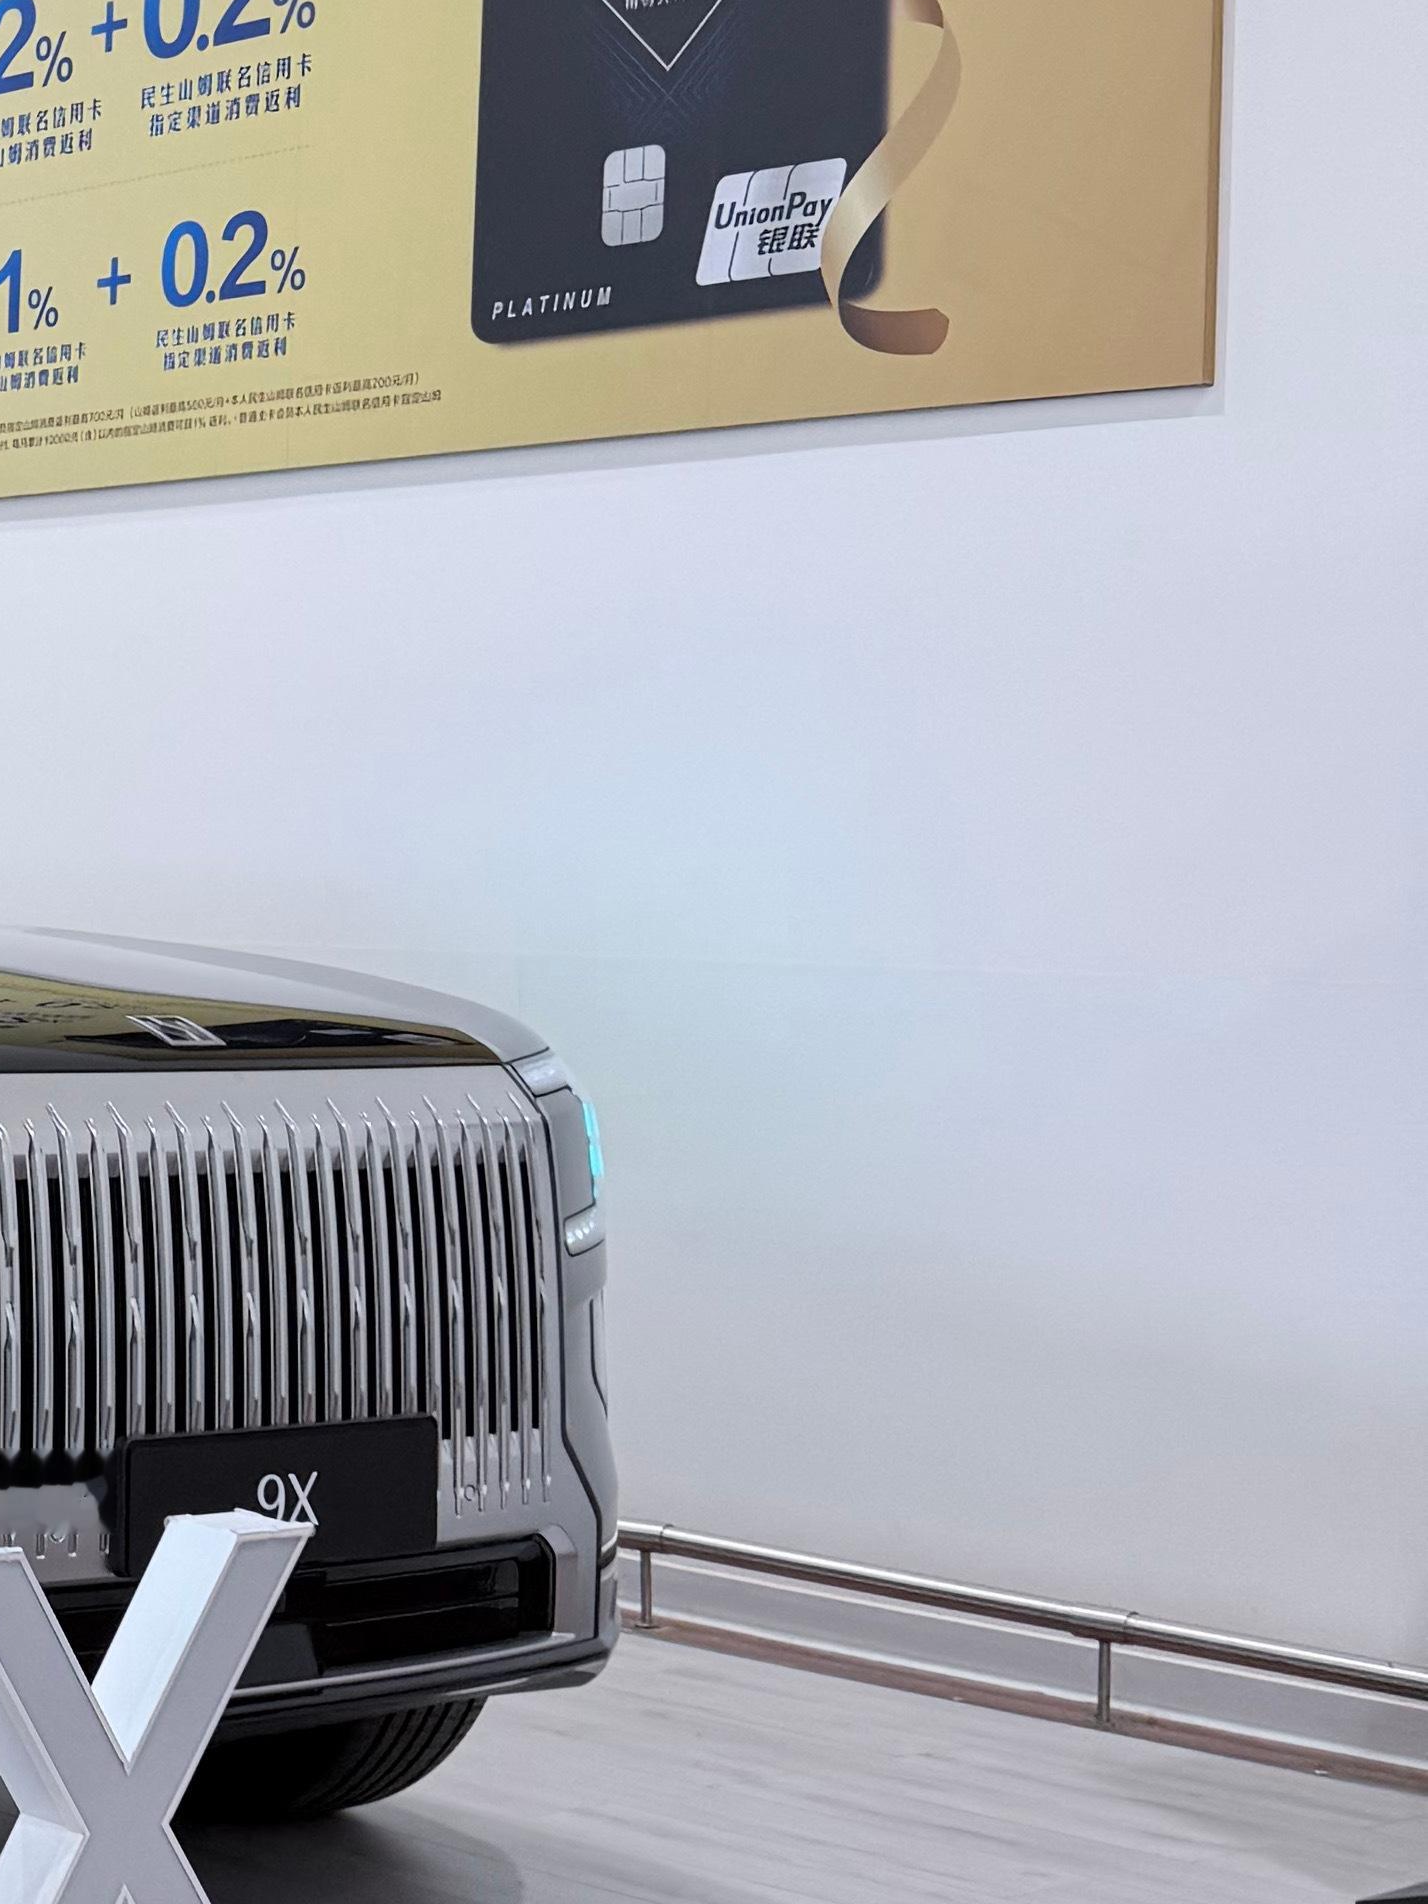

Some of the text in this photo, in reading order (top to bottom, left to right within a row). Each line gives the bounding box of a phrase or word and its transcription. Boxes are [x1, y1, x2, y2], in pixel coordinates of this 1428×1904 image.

[140, 53, 313, 110] 民生山姆联名信用卡
[148, 83, 302, 138] 指定渠道消费返利
[714, 191, 834, 230] UnionPay
[161, 209, 307, 309] 0.2%
[757, 223, 820, 256] 银联
[491, 286, 612, 321] PLATINUM
[155, 310, 297, 349] 民生山姆联名信用卡
[256, 1471, 320, 1526] 9X
